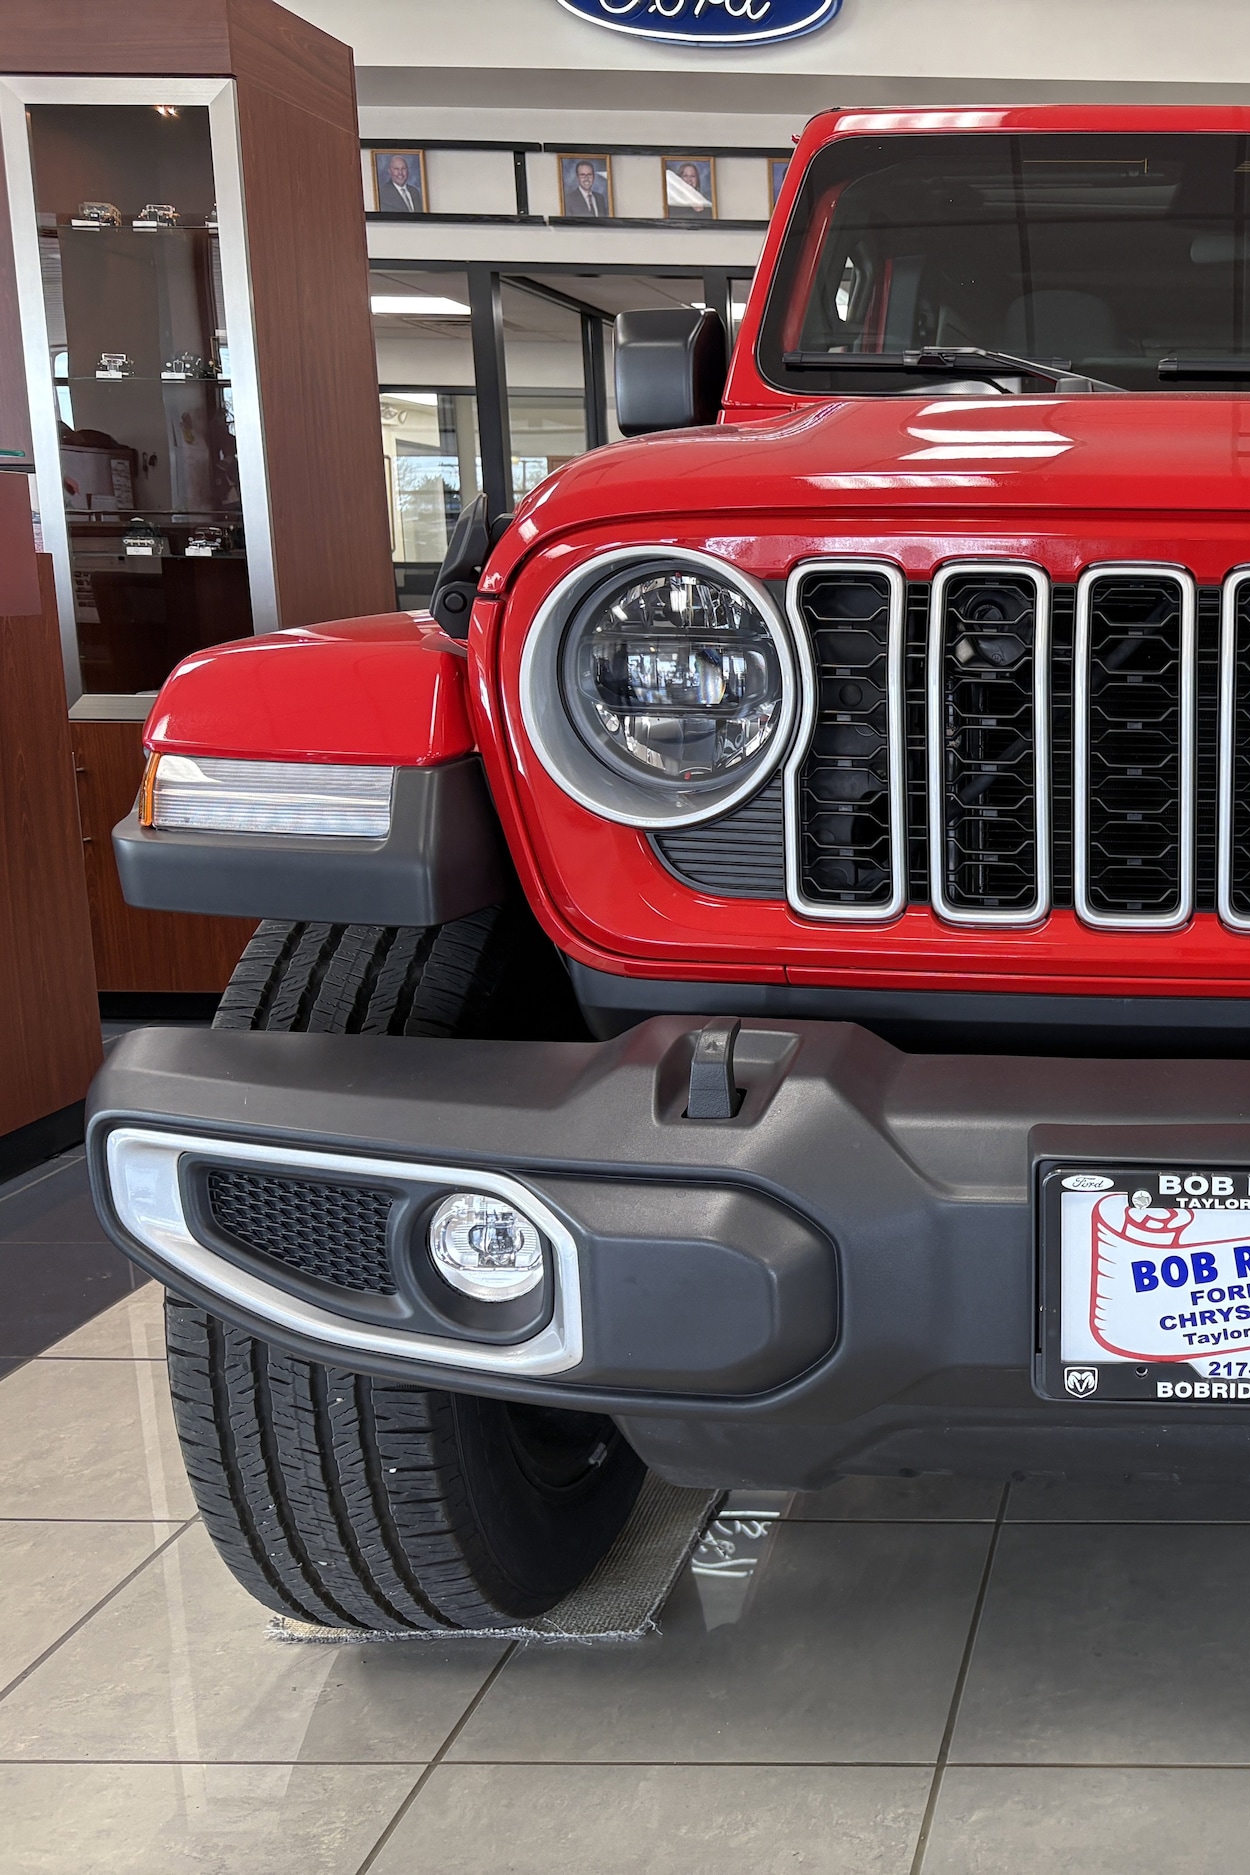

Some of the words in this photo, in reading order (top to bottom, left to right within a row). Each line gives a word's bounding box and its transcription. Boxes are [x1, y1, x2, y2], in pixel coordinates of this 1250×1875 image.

[1072, 1177, 1104, 1189] Ford
[1159, 1175, 1235, 1196] BOB
[1131, 1251, 1219, 1294] BOB
